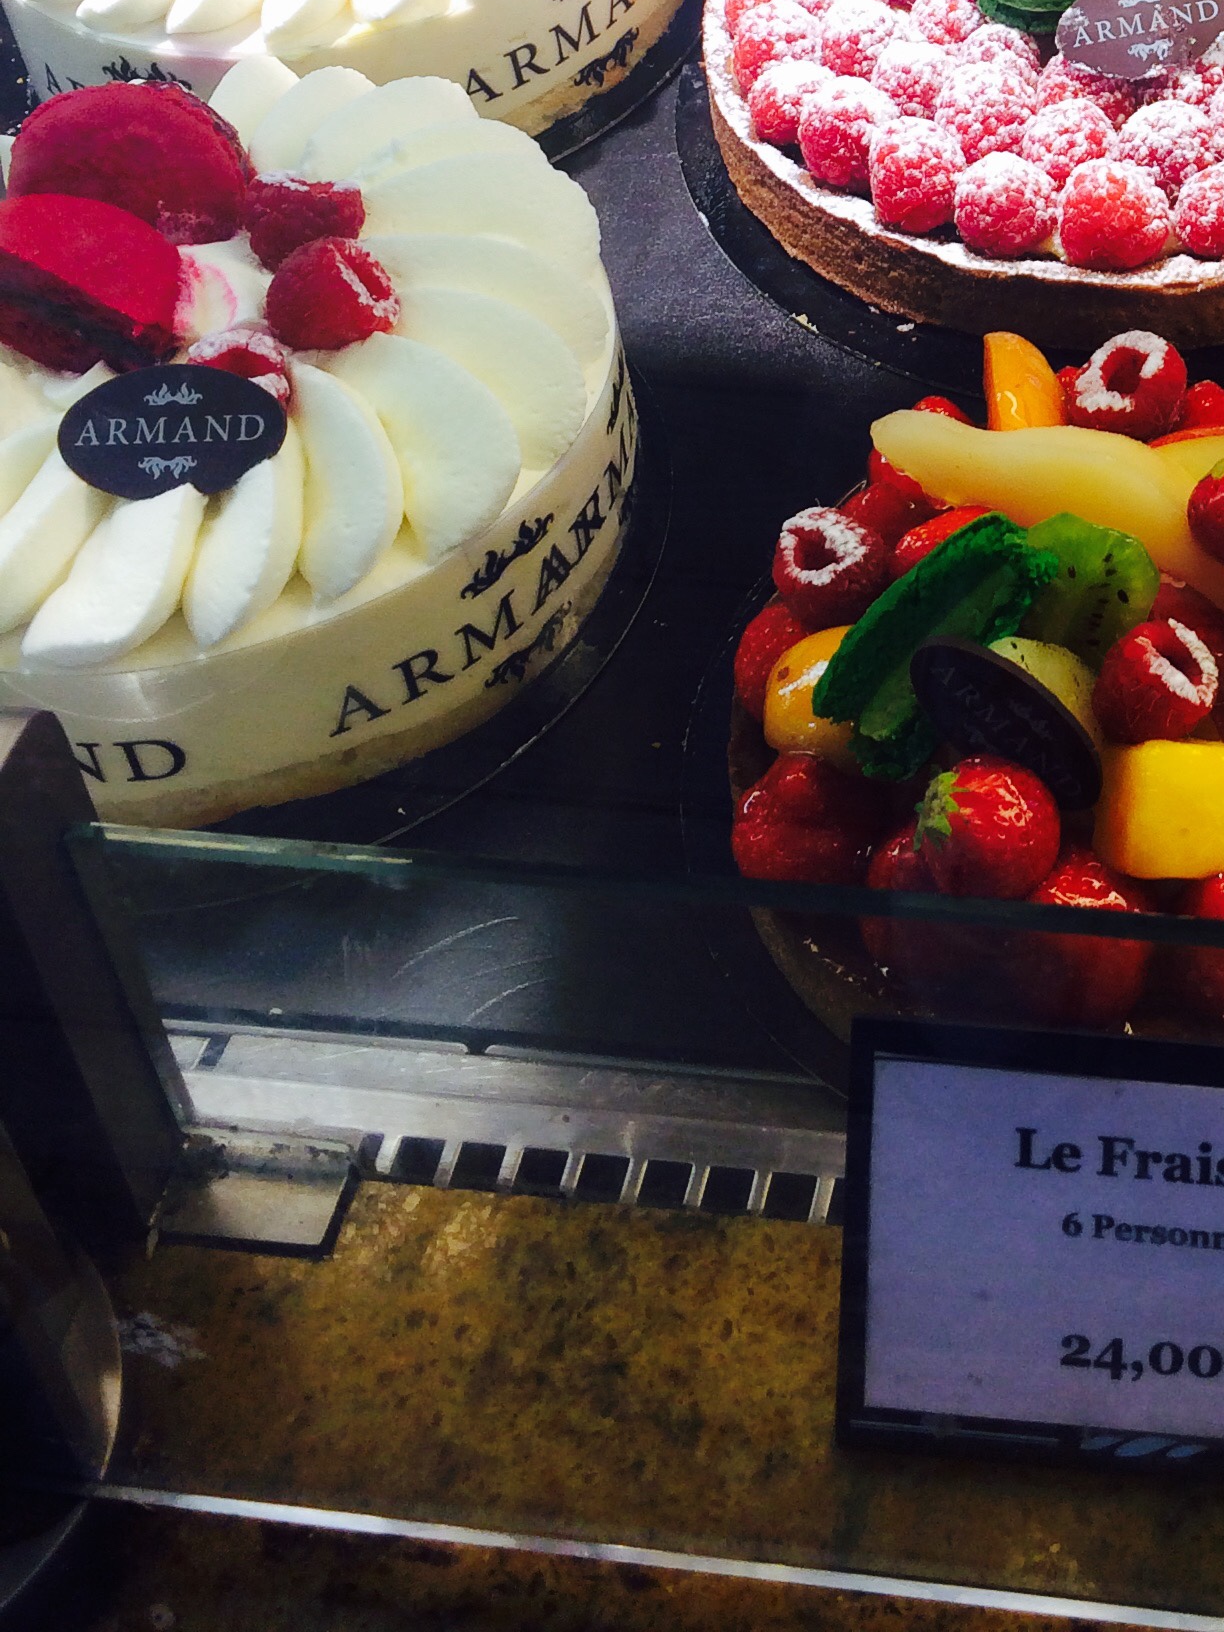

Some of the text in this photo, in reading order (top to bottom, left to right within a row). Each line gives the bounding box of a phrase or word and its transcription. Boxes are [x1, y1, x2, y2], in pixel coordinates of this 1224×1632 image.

[1073, 0, 1219, 48] ARMAND
[74, 415, 266, 447] ARMAND
[1014, 1127, 1083, 1173] Le
[1062, 1213, 1083, 1237] 6
